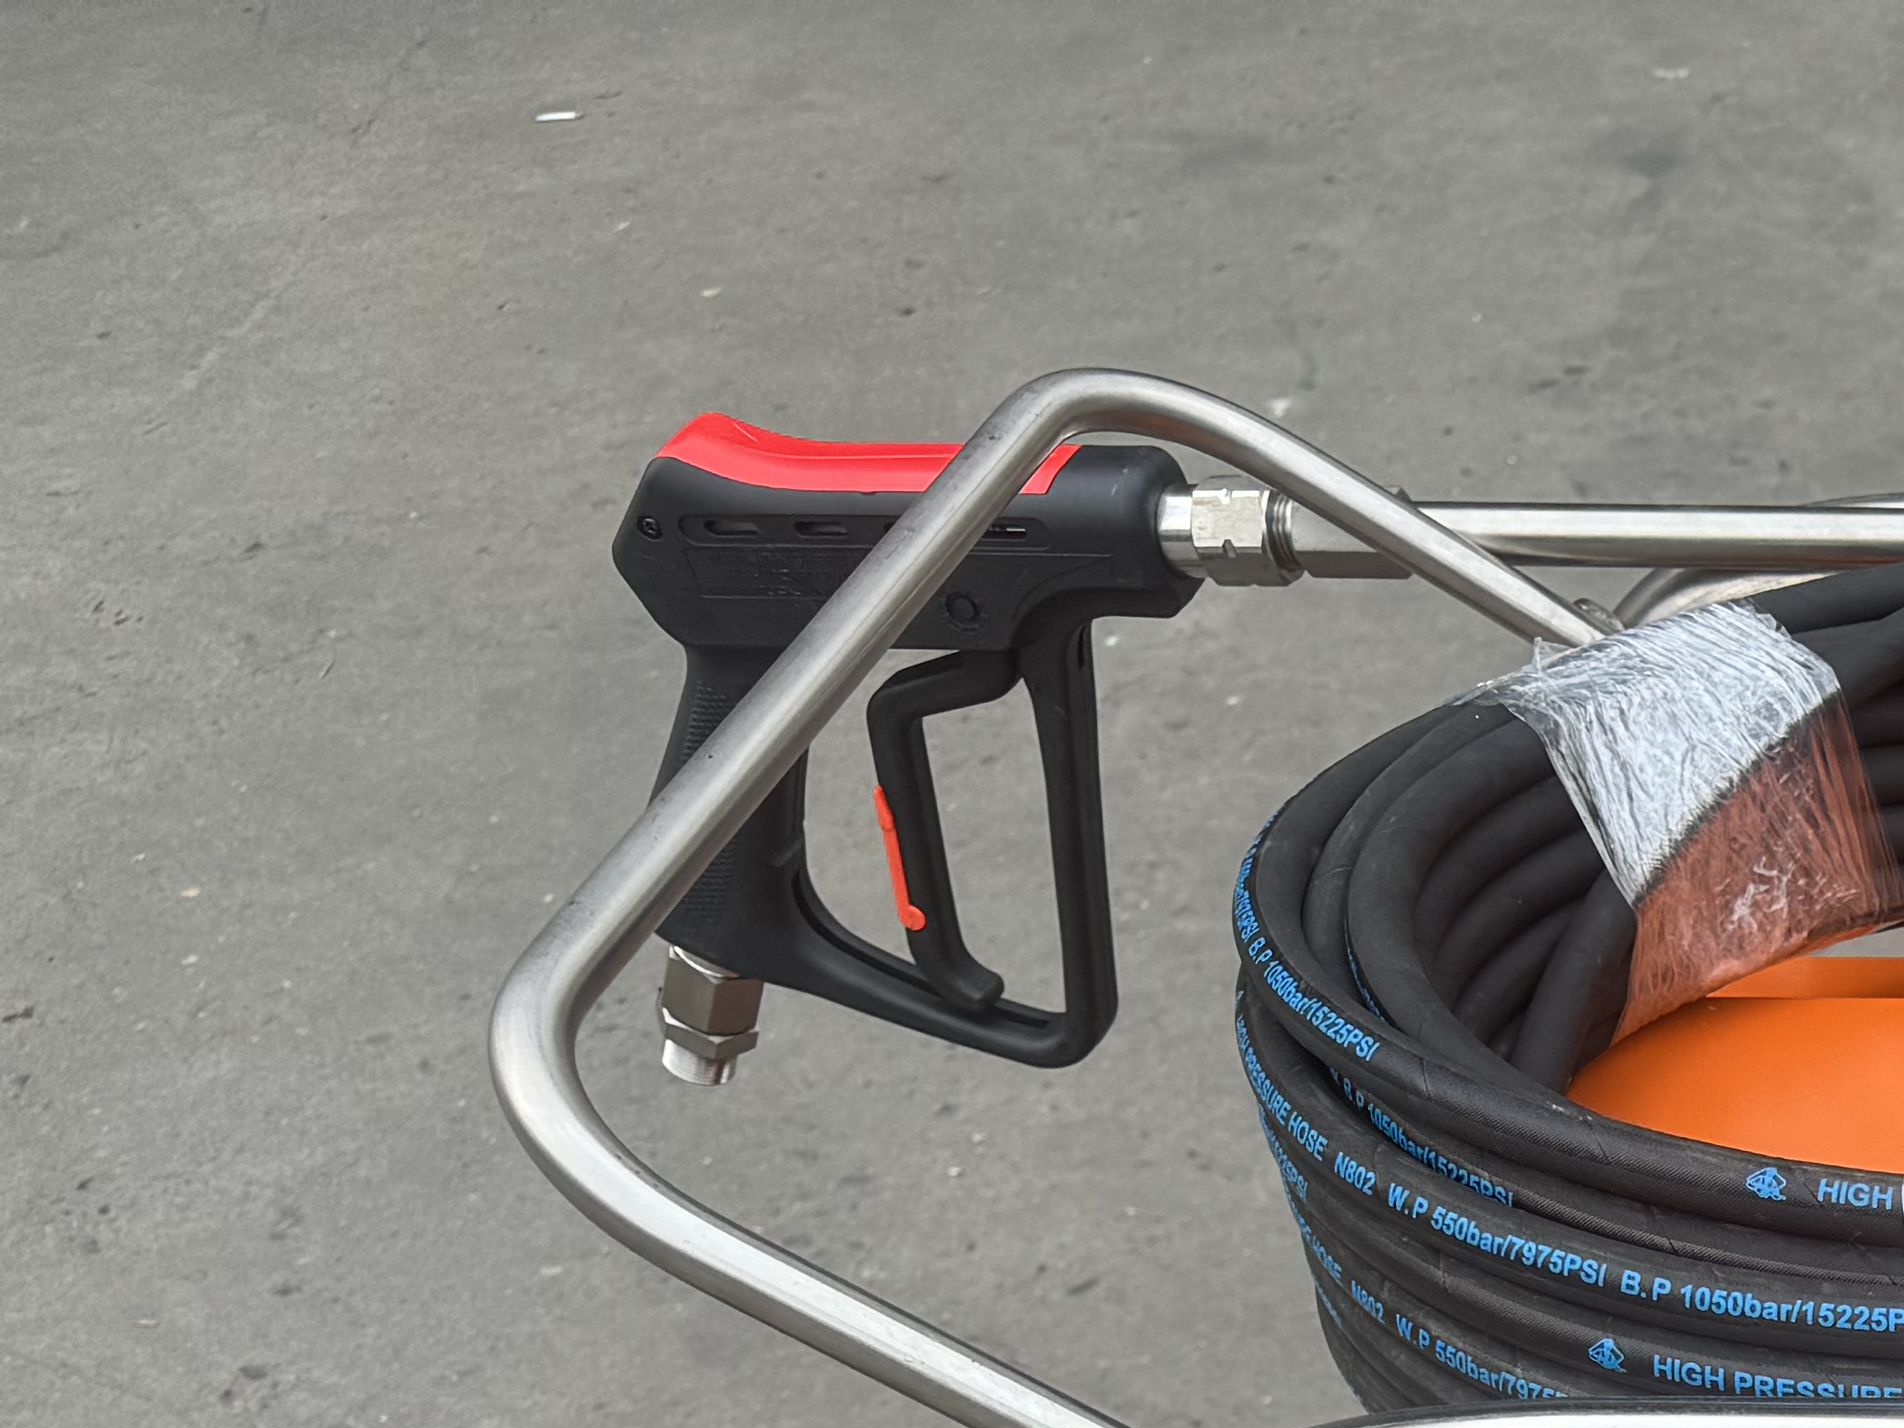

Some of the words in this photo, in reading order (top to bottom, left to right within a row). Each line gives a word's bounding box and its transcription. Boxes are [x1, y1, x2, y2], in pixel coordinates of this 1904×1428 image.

[1248, 937, 1273, 964] B.P
[1264, 961, 1381, 1061] 1050bar/15225PSI
[1288, 1111, 1328, 1161] HOSE
[1334, 1152, 1376, 1196] N802
[1388, 1183, 1428, 1218] W.P
[1431, 1206, 1607, 1287] 550bar/7975PSI
[1621, 1270, 1672, 1301] B.P
[1817, 1179, 1894, 1210] HIGH
[1396, 1314, 1430, 1349] W.P
[1653, 1356, 1725, 1392] HIGH
